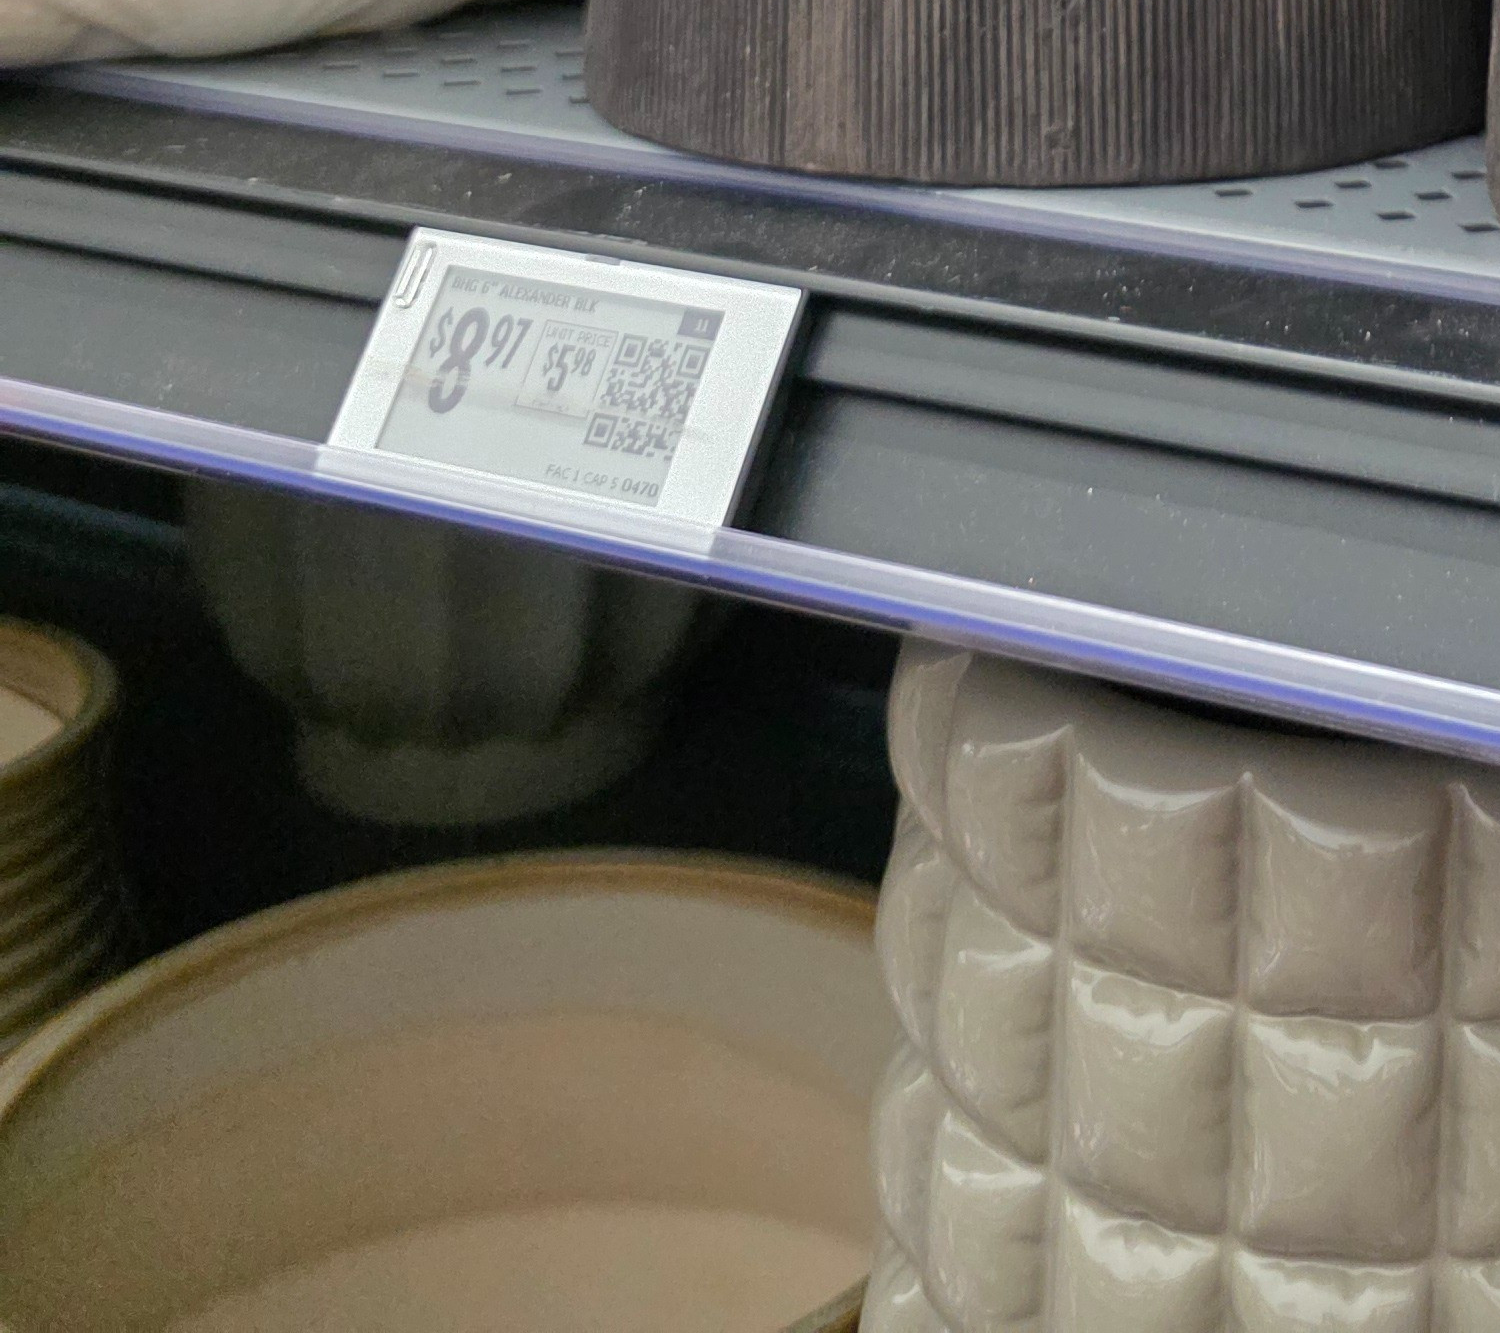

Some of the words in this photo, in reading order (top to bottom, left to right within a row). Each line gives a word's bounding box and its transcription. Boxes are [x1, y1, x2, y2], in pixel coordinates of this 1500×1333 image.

[499, 283, 571, 311] ALEXANDER
[574, 297, 600, 313] BLK
[545, 463, 572, 480] FAC
[584, 471, 609, 487] CAP
[621, 477, 660, 498] 0470
